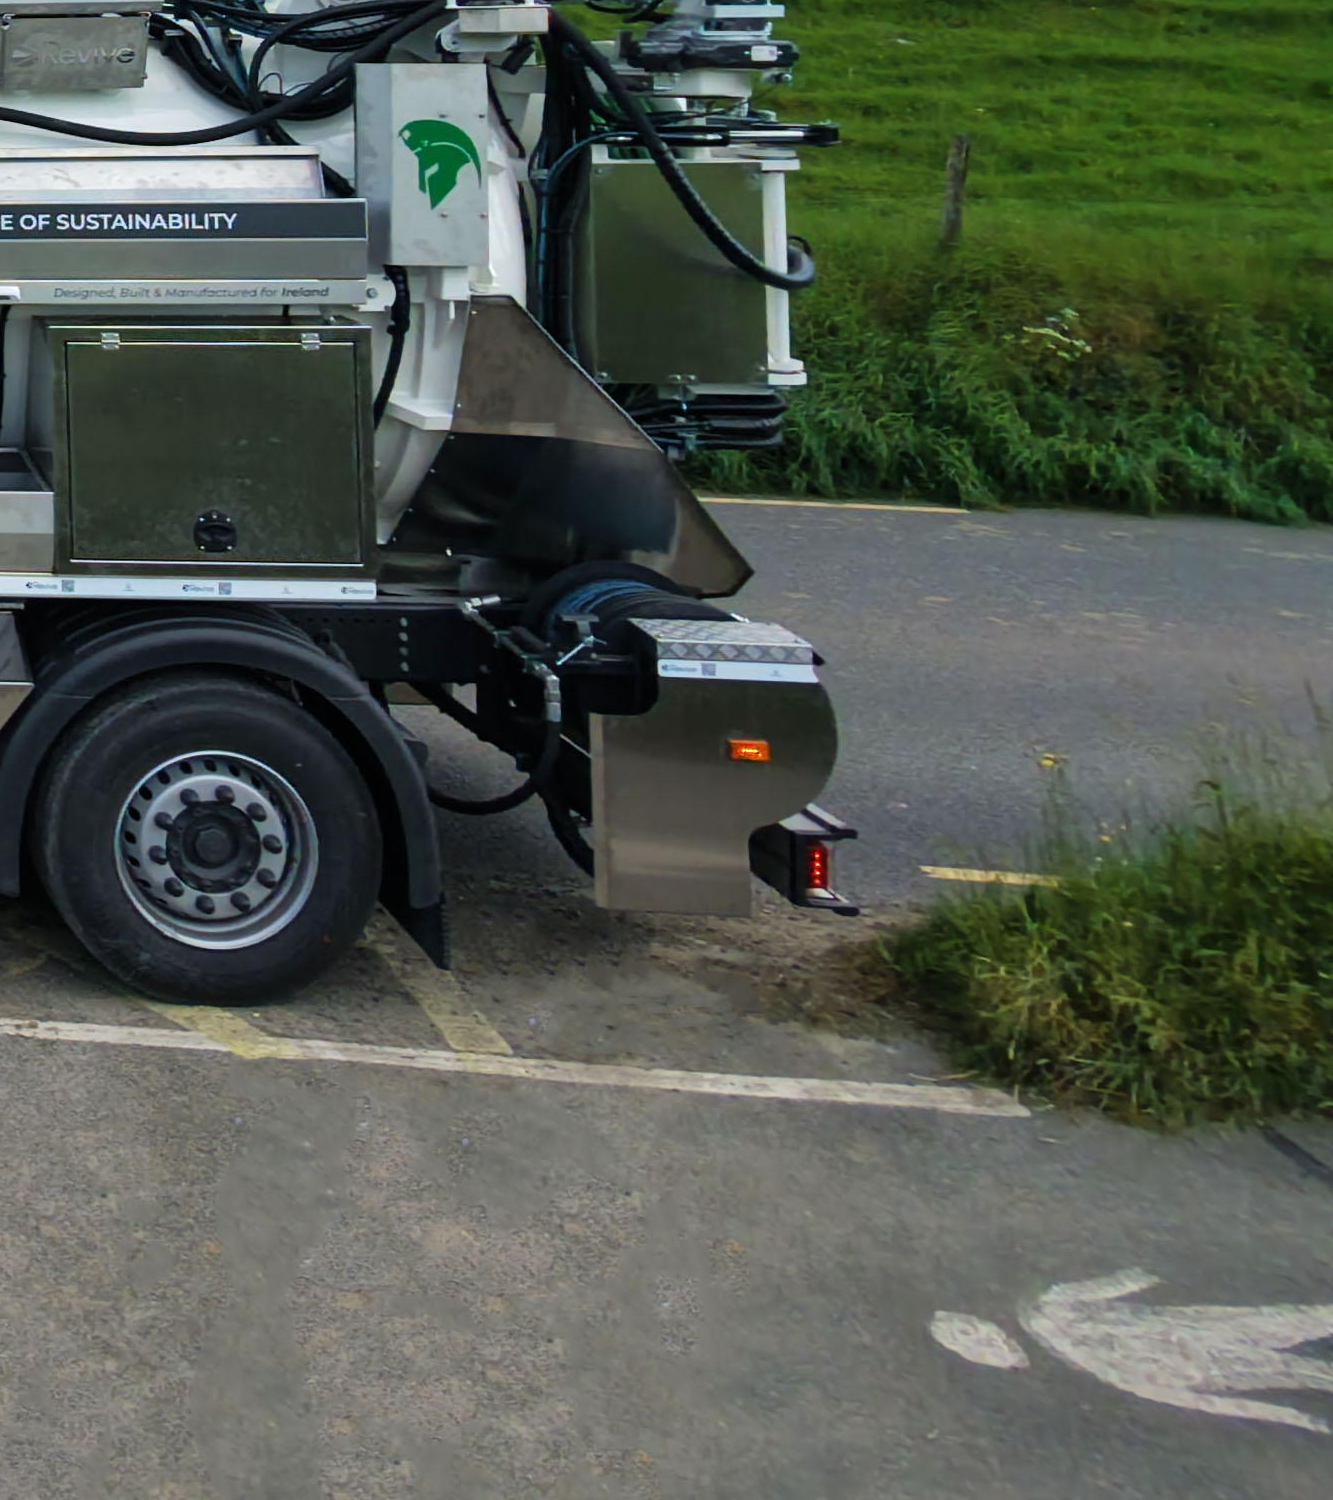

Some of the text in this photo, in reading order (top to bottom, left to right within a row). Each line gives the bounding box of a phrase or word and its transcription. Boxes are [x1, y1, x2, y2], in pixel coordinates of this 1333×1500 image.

[42, 41, 136, 64] Revive
[19, 214, 51, 231] OF
[56, 213, 238, 231] SUSTAINABILITY
[53, 287, 116, 299] Designed,
[120, 287, 150, 298] Built
[165, 287, 257, 298] Manufactured
[261, 287, 277, 298] for
[282, 286, 329, 297] Ireland
